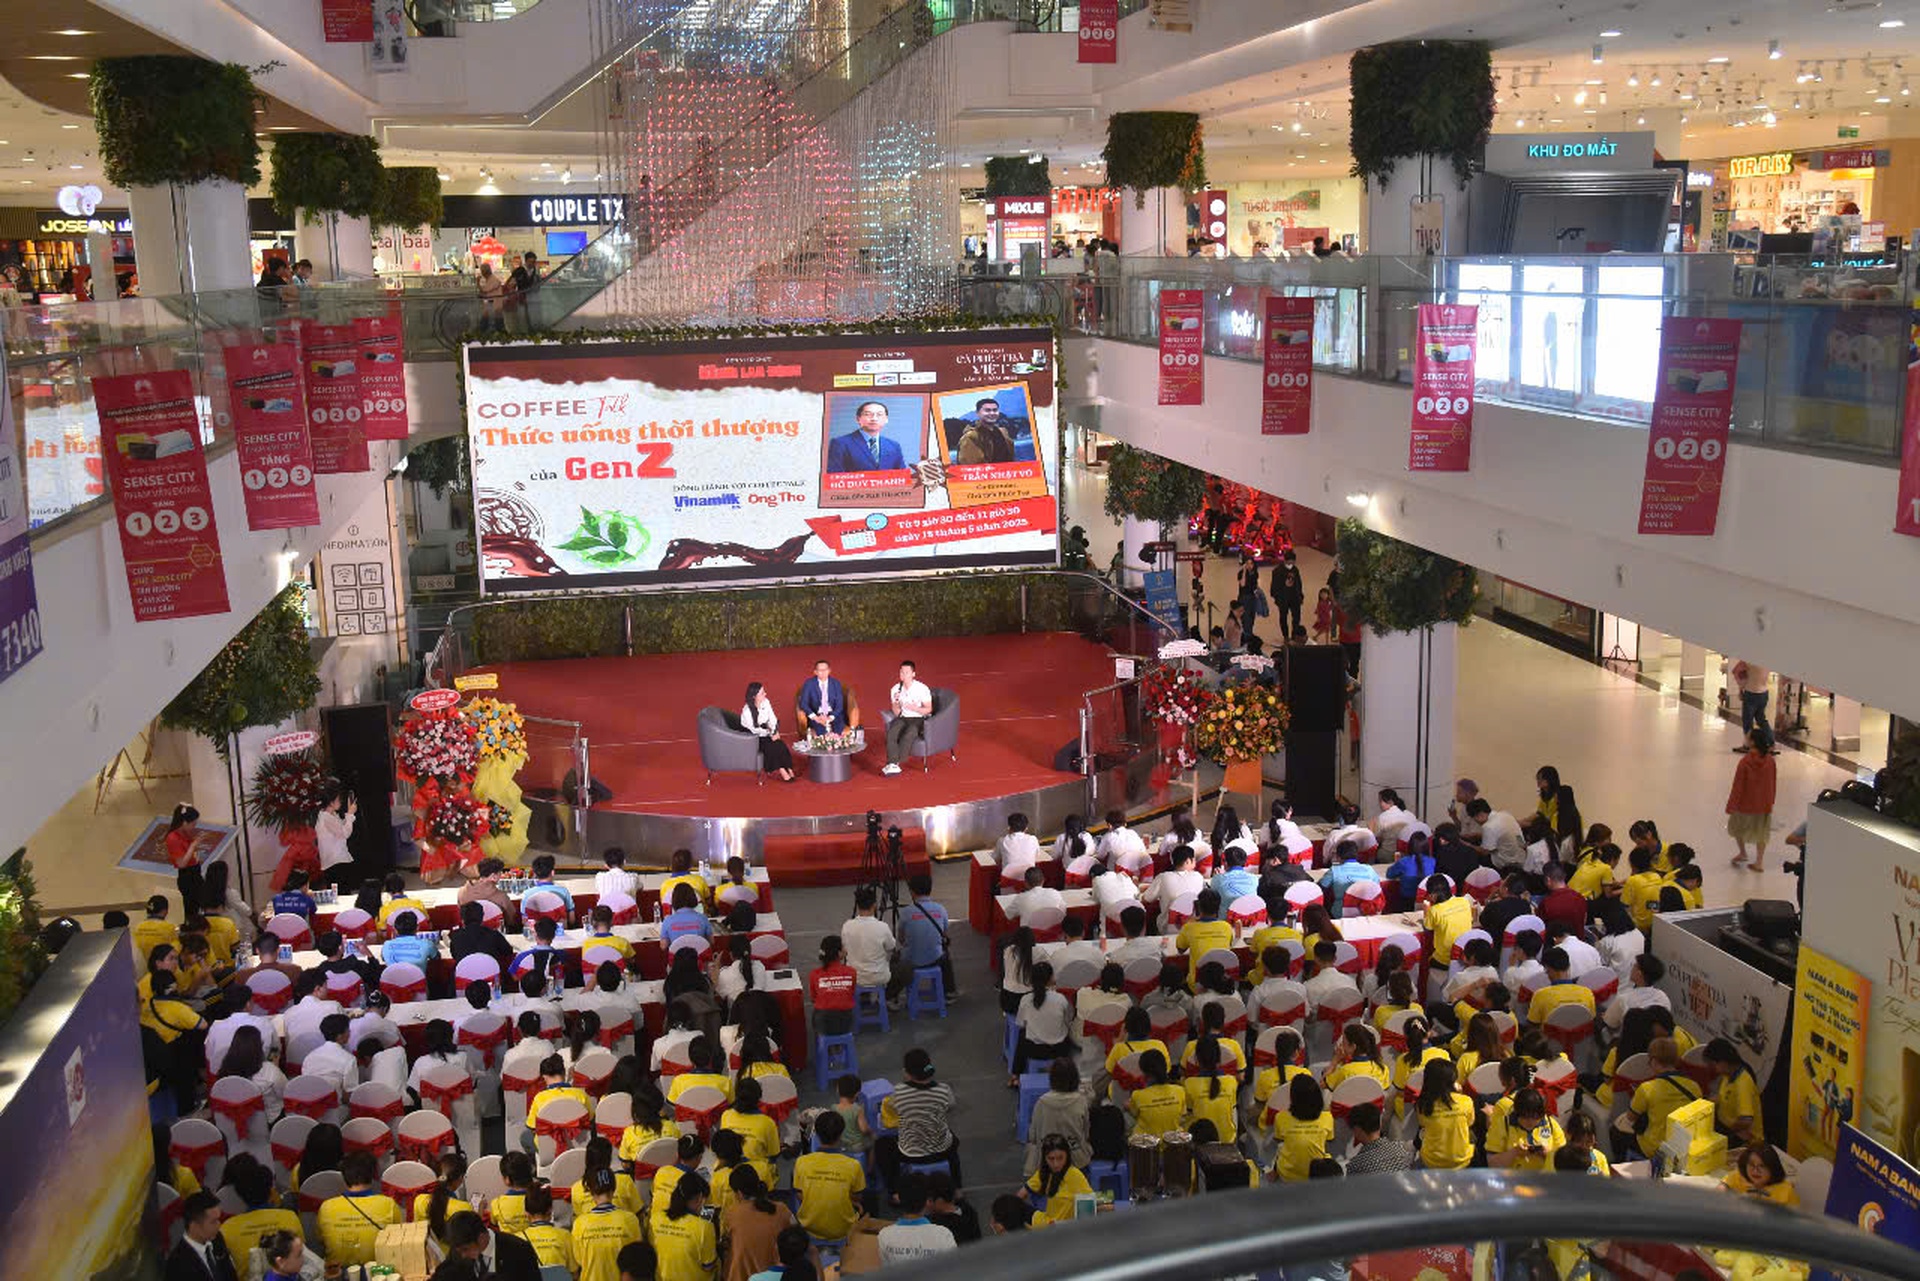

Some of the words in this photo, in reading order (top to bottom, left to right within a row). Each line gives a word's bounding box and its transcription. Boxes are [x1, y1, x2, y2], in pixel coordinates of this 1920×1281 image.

[1529, 145, 1559, 157] KHU
[1563, 144, 1584, 157] ĐO
[1587, 136, 1617, 157] MẮT
[530, 199, 597, 223] COUPLE
[602, 198, 625, 221] TX
[1004, 201, 1045, 214] MIXUE
[402, 233, 431, 249] baa
[1422, 372, 1448, 381] SENSE
[1449, 372, 1469, 381] CITY
[477, 400, 587, 419] COFFEE
[1662, 406, 1697, 417] SENSE
[1698, 406, 1723, 417] CITY
[243, 434, 276, 445] SENSE
[278, 431, 301, 442] CITY
[480, 425, 554, 447] Thức
[560, 421, 631, 445] uống
[638, 418, 694, 441] thời
[701, 418, 800, 441] thượng
[1683, 443, 1694, 455] 2
[1706, 443, 1716, 456] 3
[123, 475, 164, 489] SENSE
[167, 471, 196, 484] CITY
[272, 471, 282, 484] 2
[296, 469, 305, 482] 3
[530, 468, 558, 482] của
[673, 492, 741, 508] Vinamilk
[134, 517, 144, 532] 1
[162, 514, 174, 529] 2
[190, 511, 202, 526] 3
[323, 538, 388, 550] NFORMATION
[1850, 1142, 1880, 1172] NAM
[1879, 1163, 1889, 1179] A
[1889, 1169, 1920, 1200] BAN
